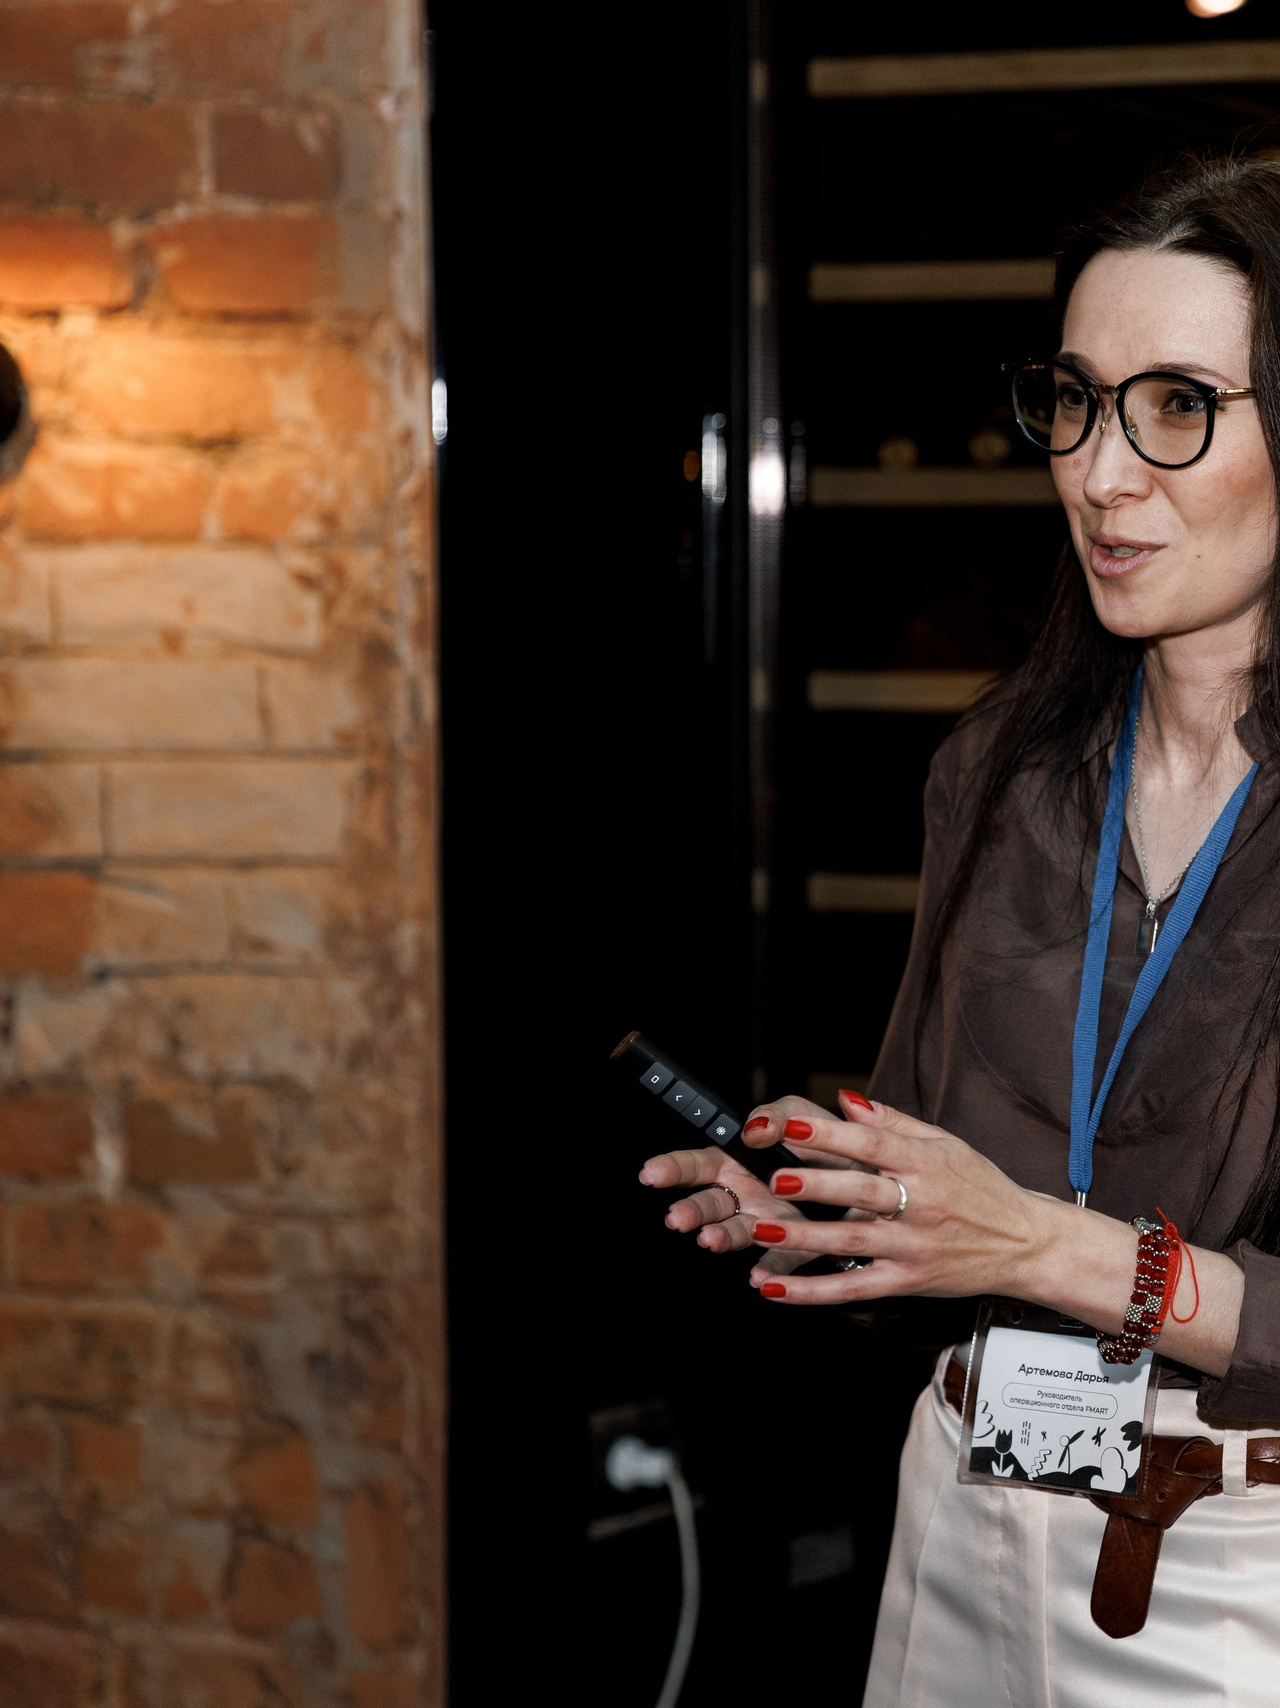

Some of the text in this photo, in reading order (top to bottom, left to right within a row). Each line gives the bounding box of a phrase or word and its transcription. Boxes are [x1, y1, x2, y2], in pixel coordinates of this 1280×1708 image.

[1018, 1363, 1110, 1383] Артемова Дарья
[1036, 1390, 1082, 1402] Руководитель
[1009, 1397, 1108, 1415] операционного отдела FMART
